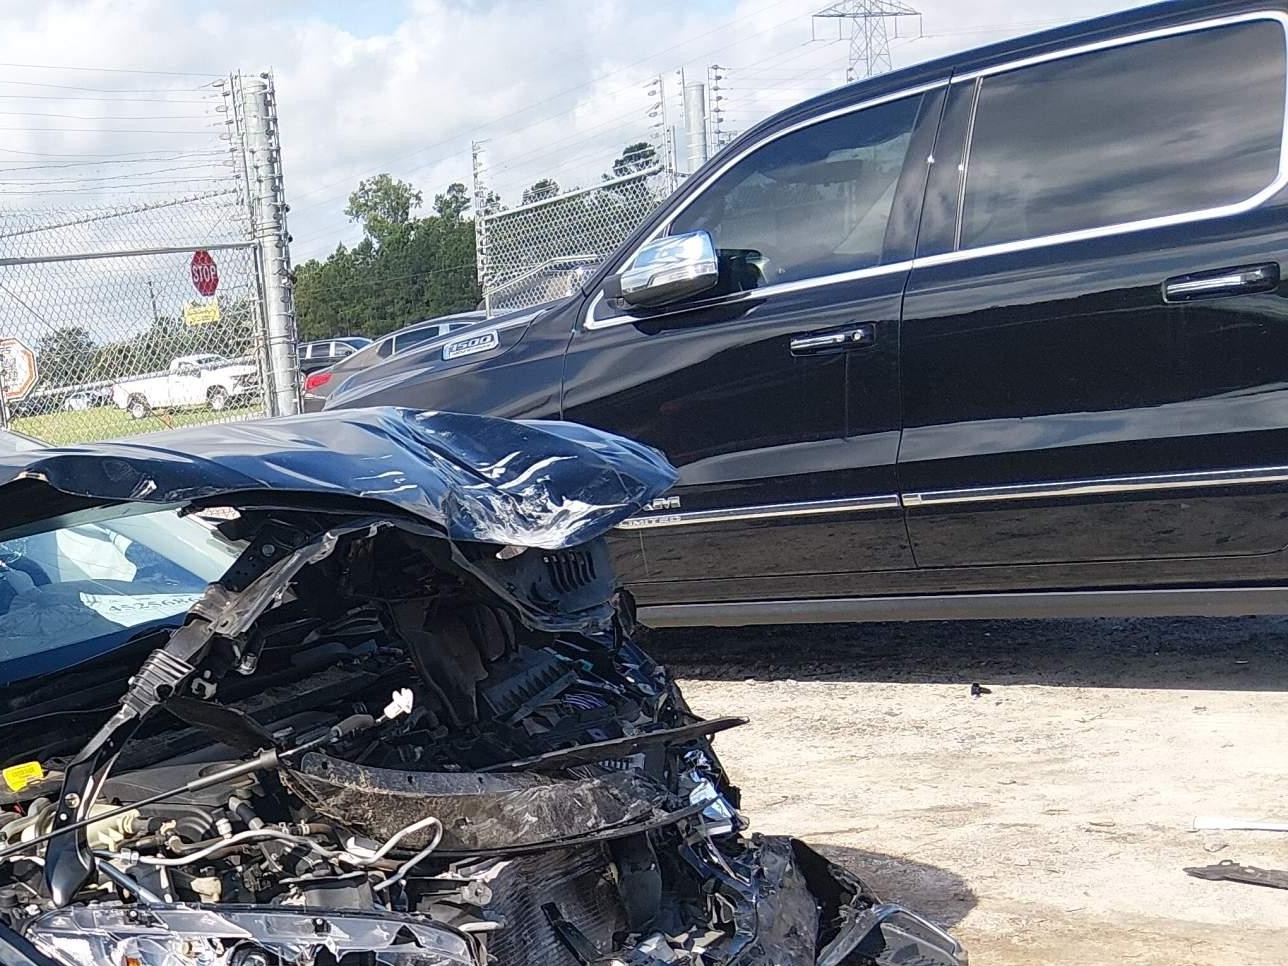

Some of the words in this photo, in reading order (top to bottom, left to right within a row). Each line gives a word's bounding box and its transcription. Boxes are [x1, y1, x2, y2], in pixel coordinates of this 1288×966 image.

[192, 264, 216, 283] STOP
[450, 334, 493, 352] 1500
[642, 495, 681, 511] AM
